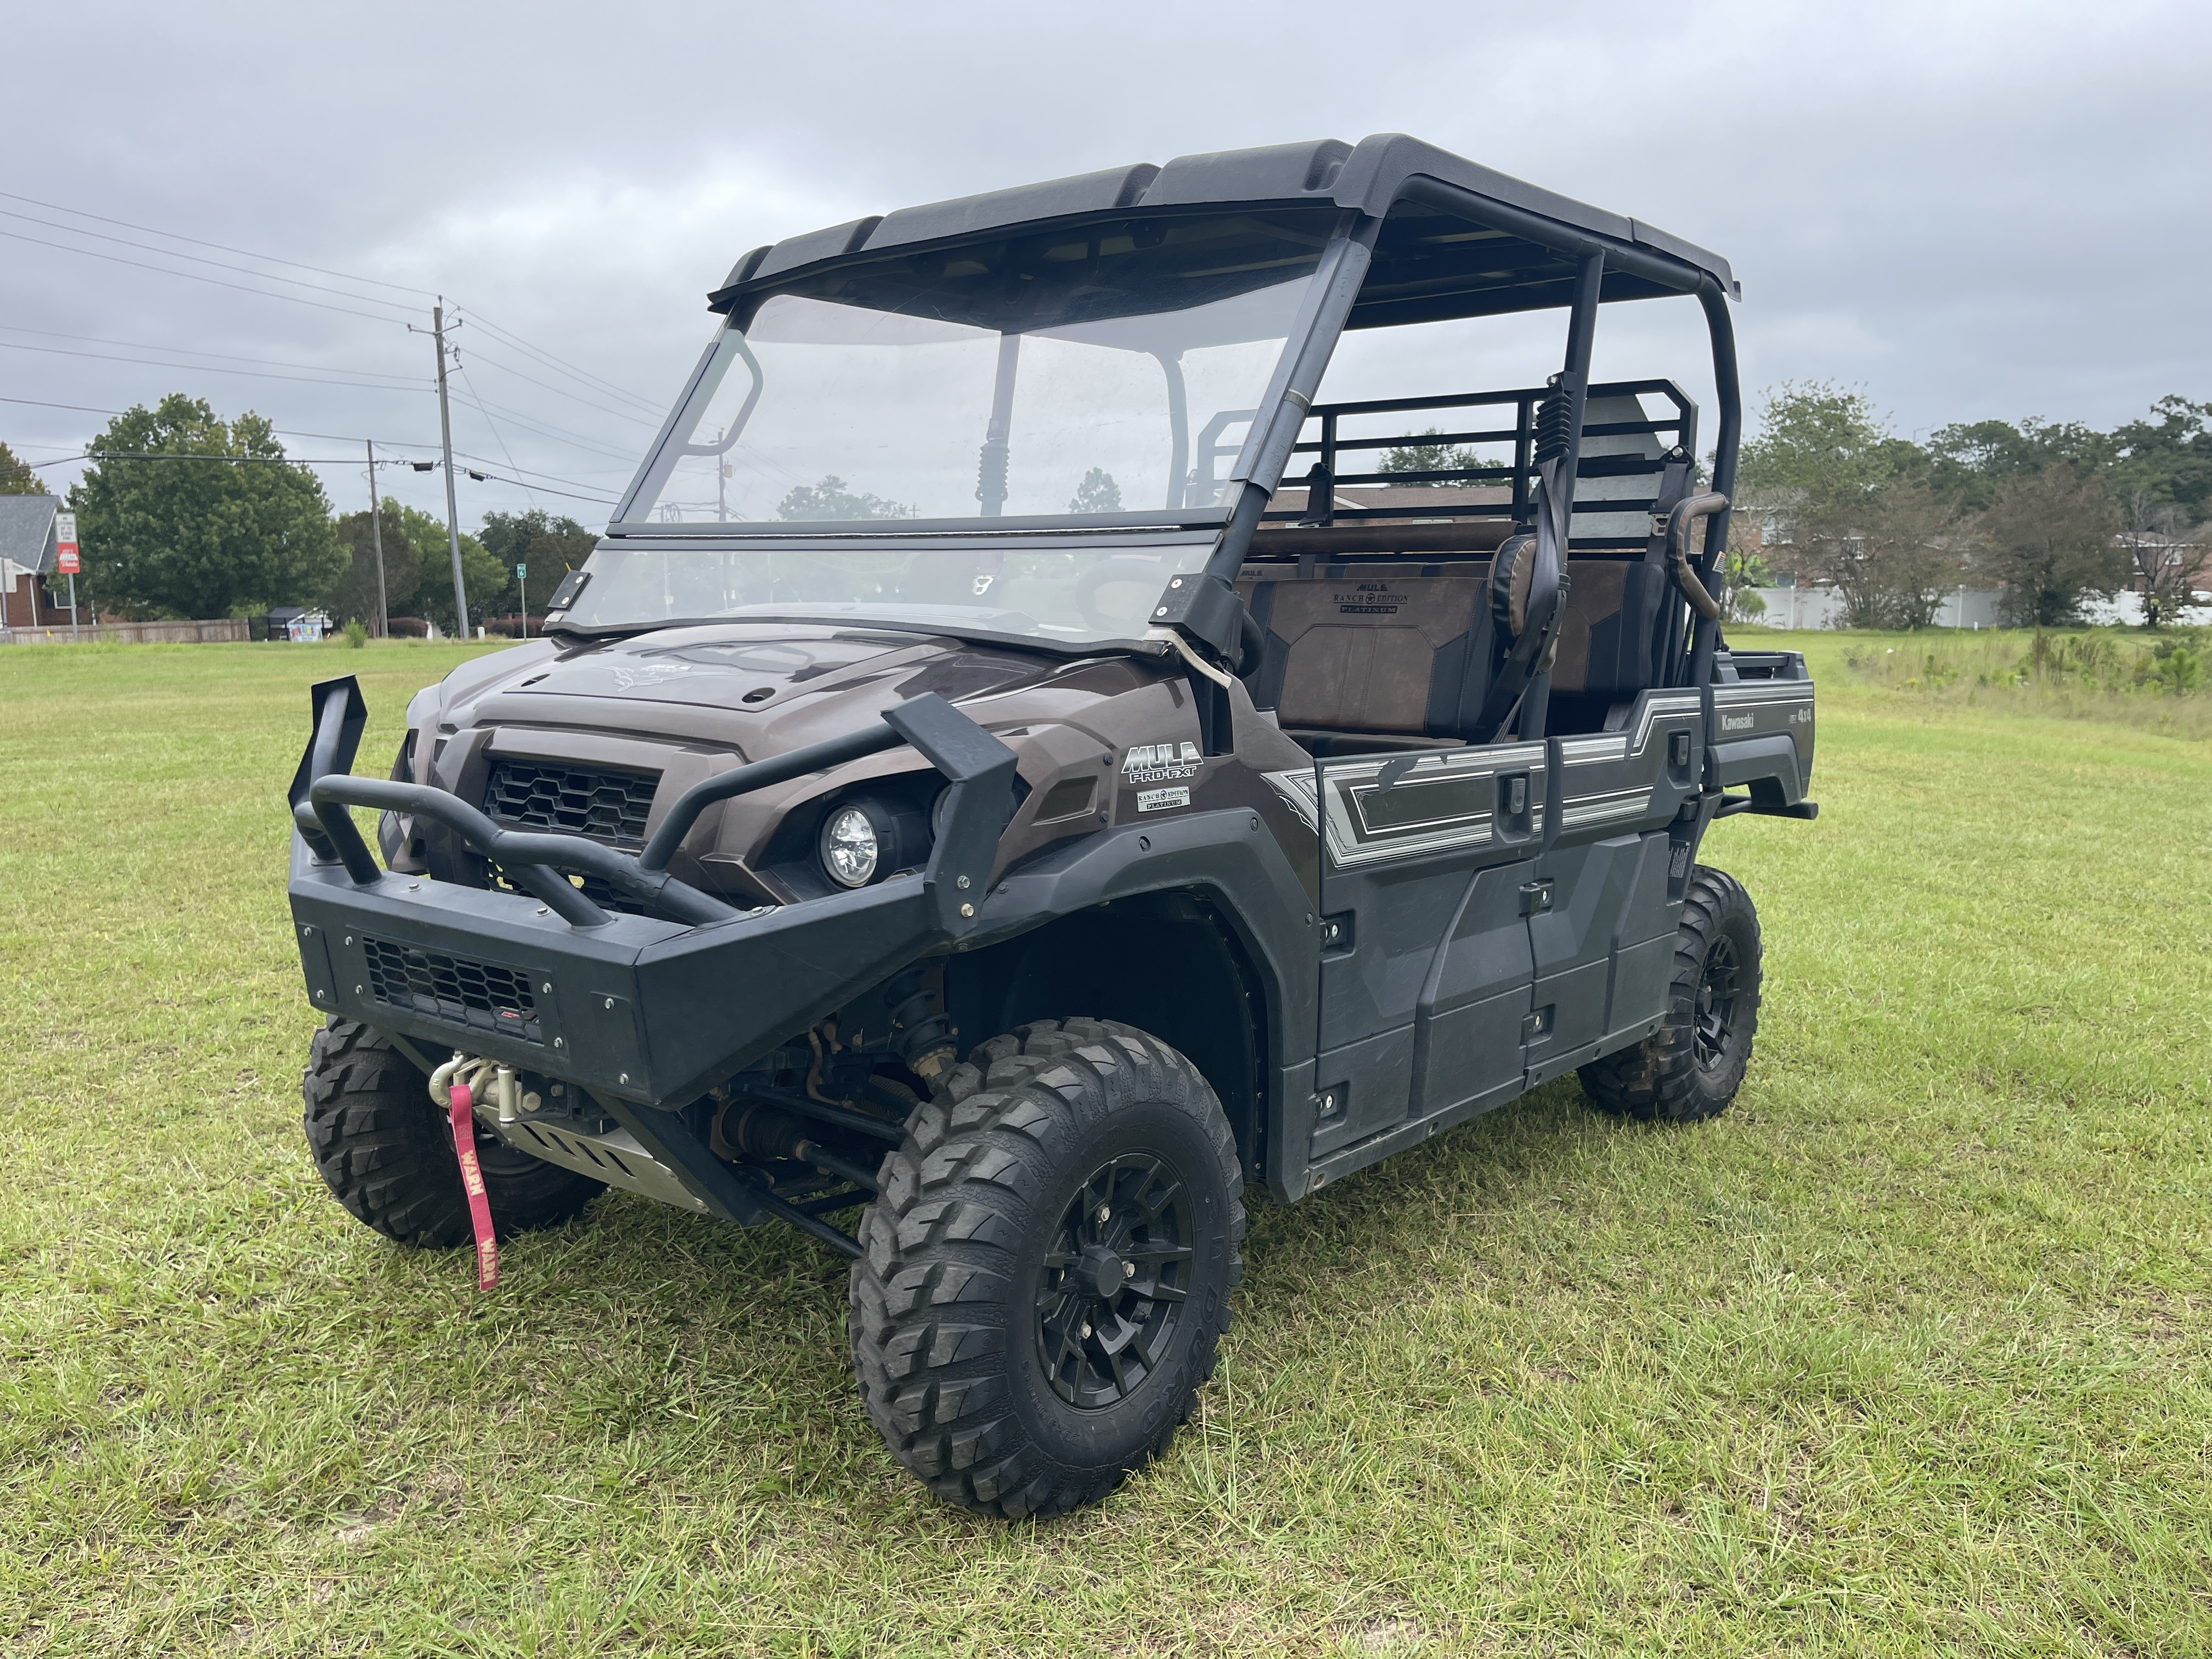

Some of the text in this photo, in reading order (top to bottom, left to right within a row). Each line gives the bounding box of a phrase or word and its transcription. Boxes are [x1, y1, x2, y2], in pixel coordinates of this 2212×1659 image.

[1722, 713, 1754, 731] Kawasaki
[1798, 708, 1812, 723] 4x4
[1121, 742, 1204, 774] MULE
[1130, 766, 1197, 784] PRO-FXT
[1138, 789, 1188, 802] RANCH EDITION
[1148, 800, 1181, 809] PLATINUM
[461, 1149, 484, 1196] WARN
[481, 1237, 496, 1283] WARN
